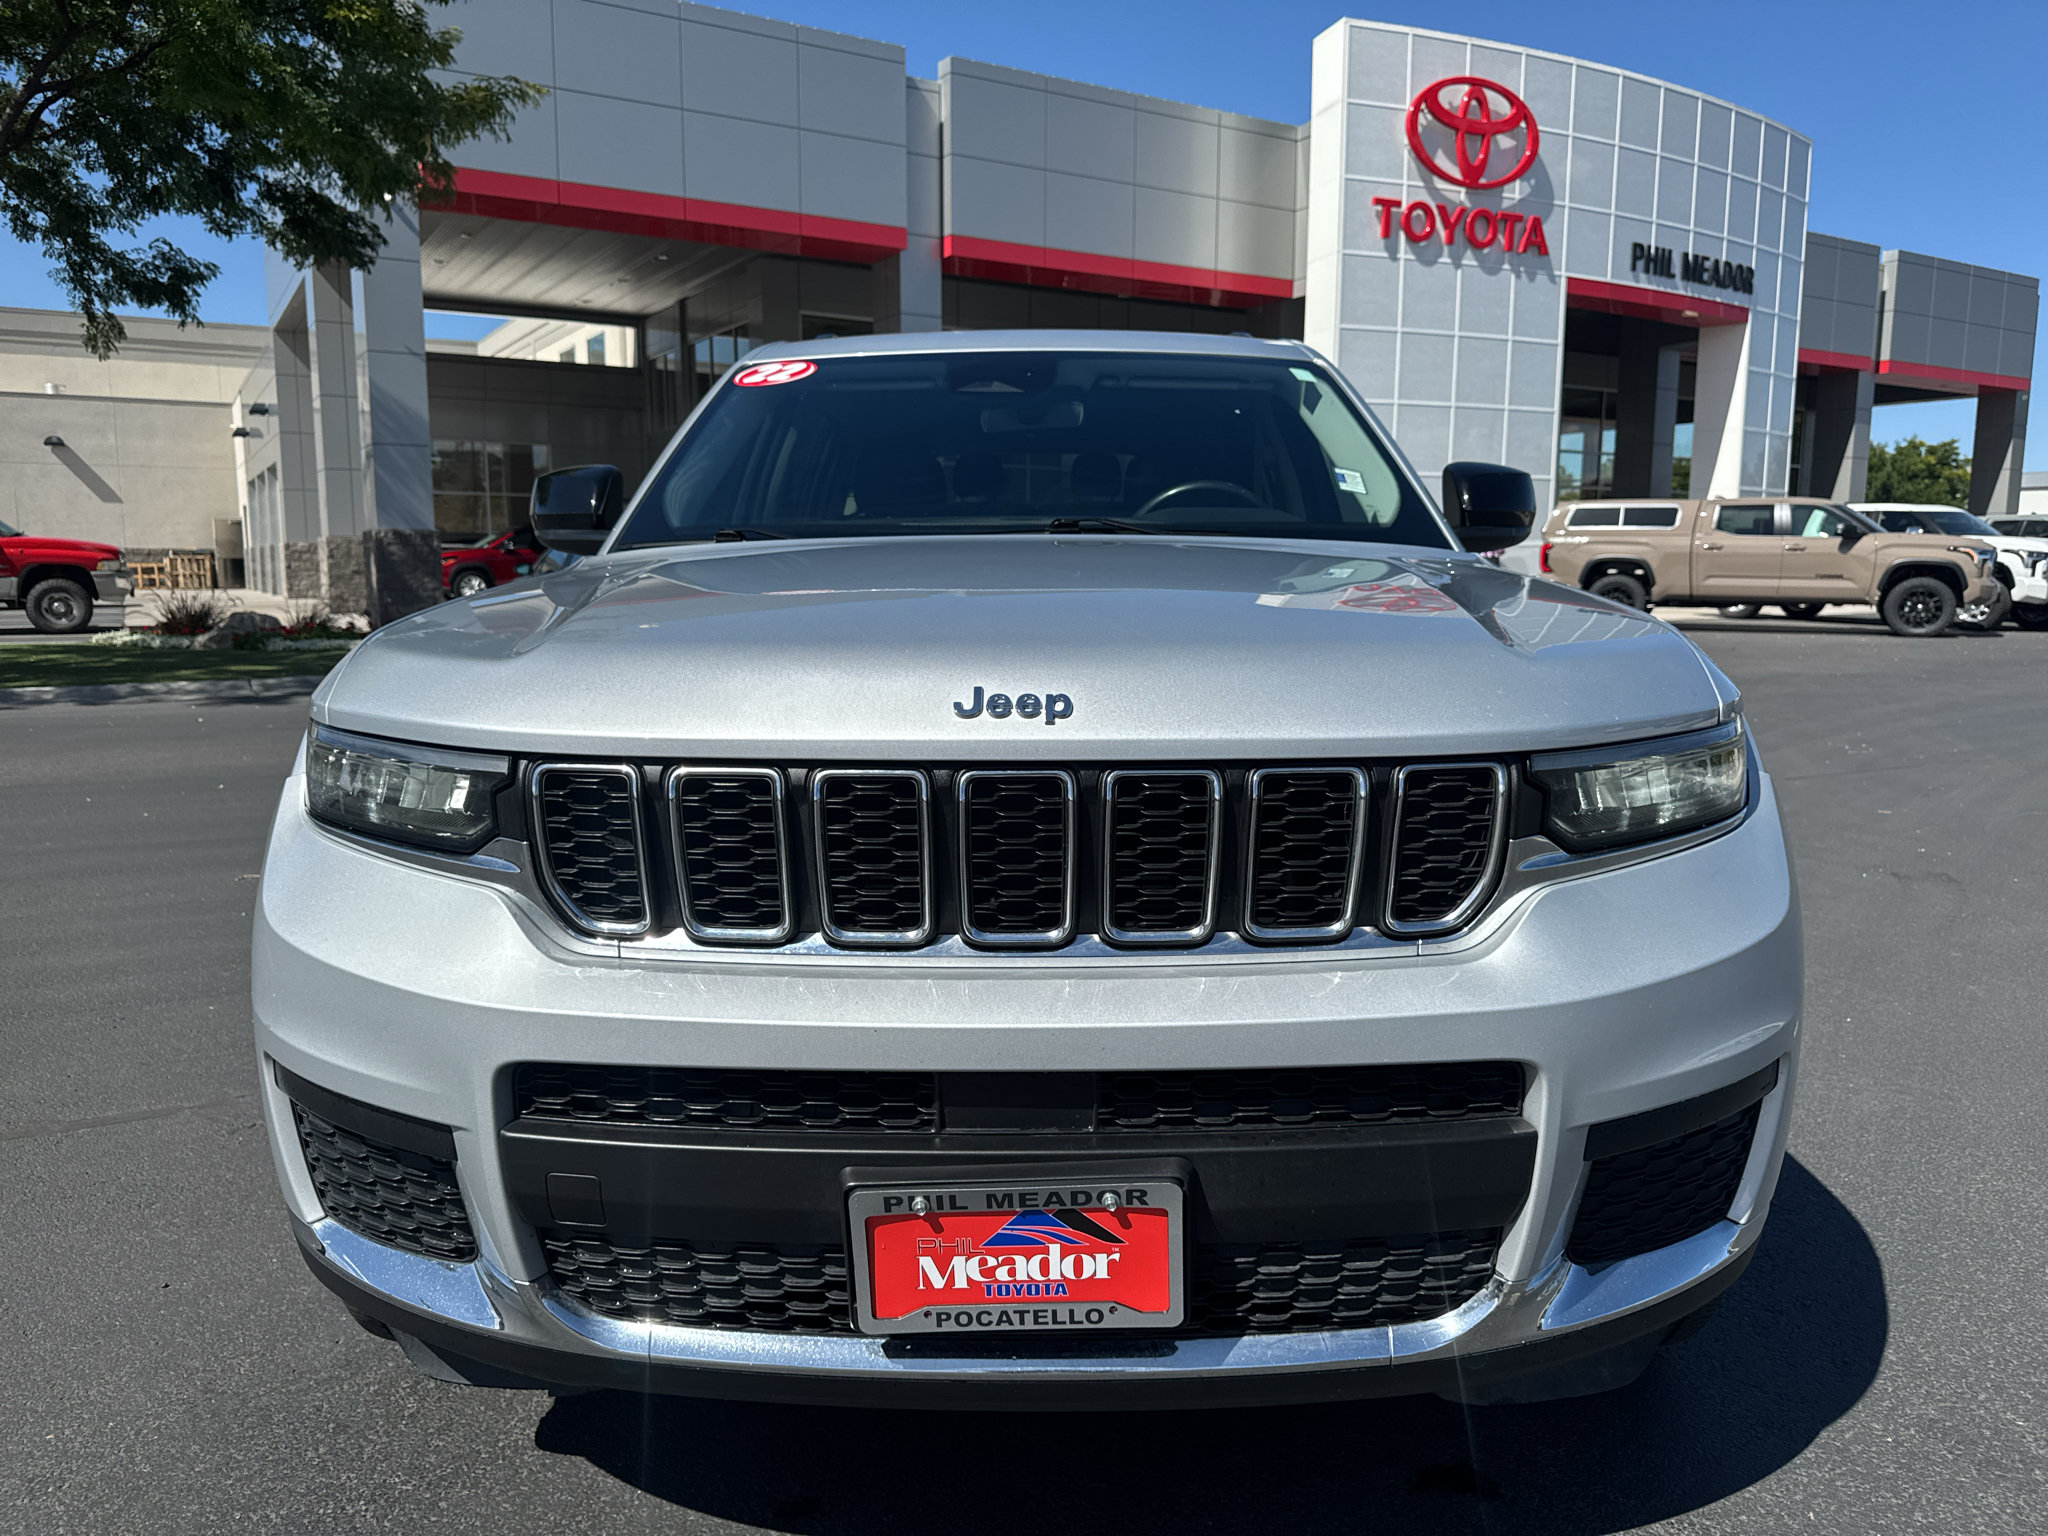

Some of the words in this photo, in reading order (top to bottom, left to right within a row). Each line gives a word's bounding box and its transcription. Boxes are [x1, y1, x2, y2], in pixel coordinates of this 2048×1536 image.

[1371, 197, 1549, 256] TOYOTA
[1631, 242, 1676, 279] PHIL
[1682, 252, 1755, 295] MEADOR
[742, 361, 807, 384] 22
[953, 686, 1074, 725] Jeep
[883, 1195, 969, 1213] PHIL
[917, 1238, 986, 1255] PHIL
[916, 1243, 1121, 1290] Meador
[983, 1283, 1069, 1298] TOYOTA
[935, 1308, 1105, 1328] POCATELLO
